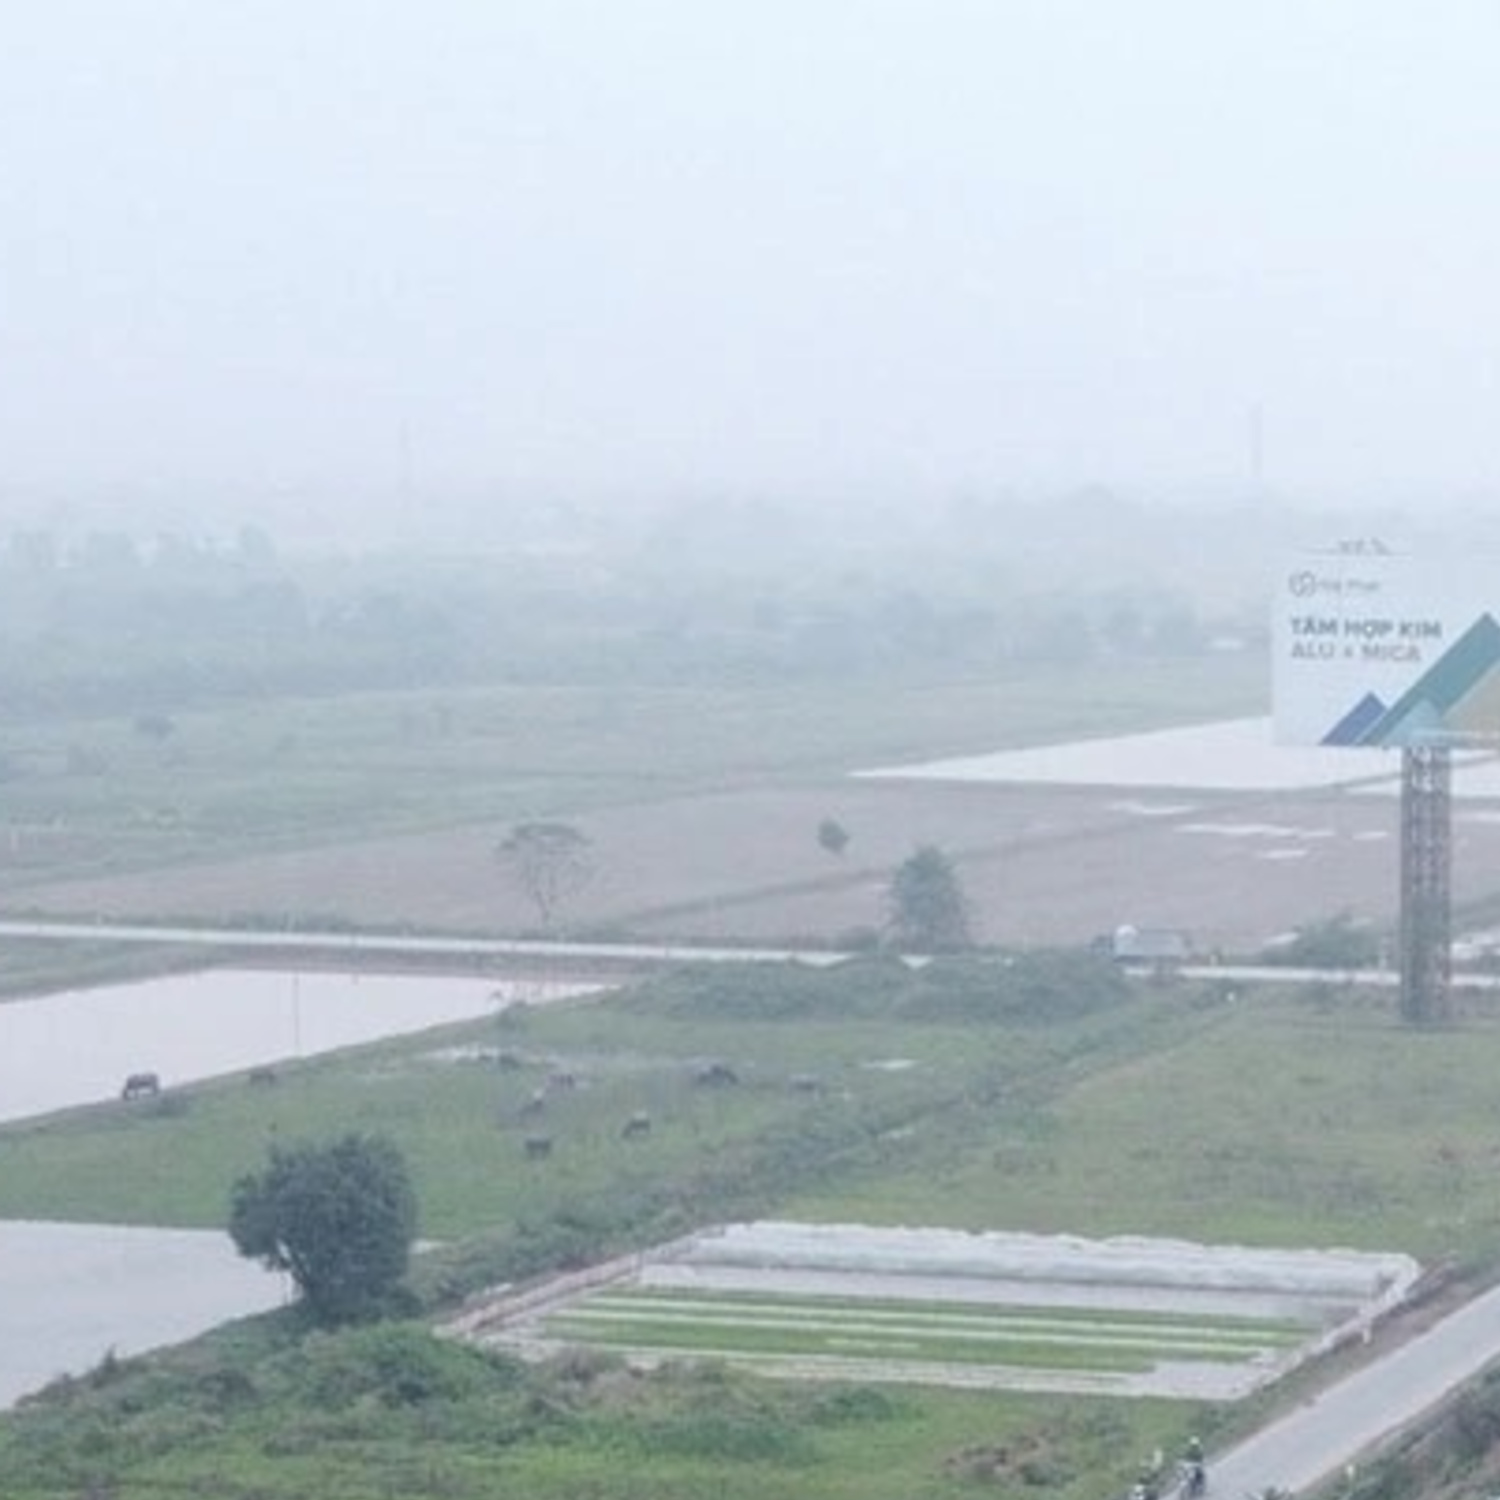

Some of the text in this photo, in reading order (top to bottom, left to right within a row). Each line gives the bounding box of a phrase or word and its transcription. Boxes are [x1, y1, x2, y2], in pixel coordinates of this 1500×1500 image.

[1399, 618, 1442, 638] KIM
[1291, 642, 1335, 660] ALU
[1361, 643, 1422, 662] MICA
